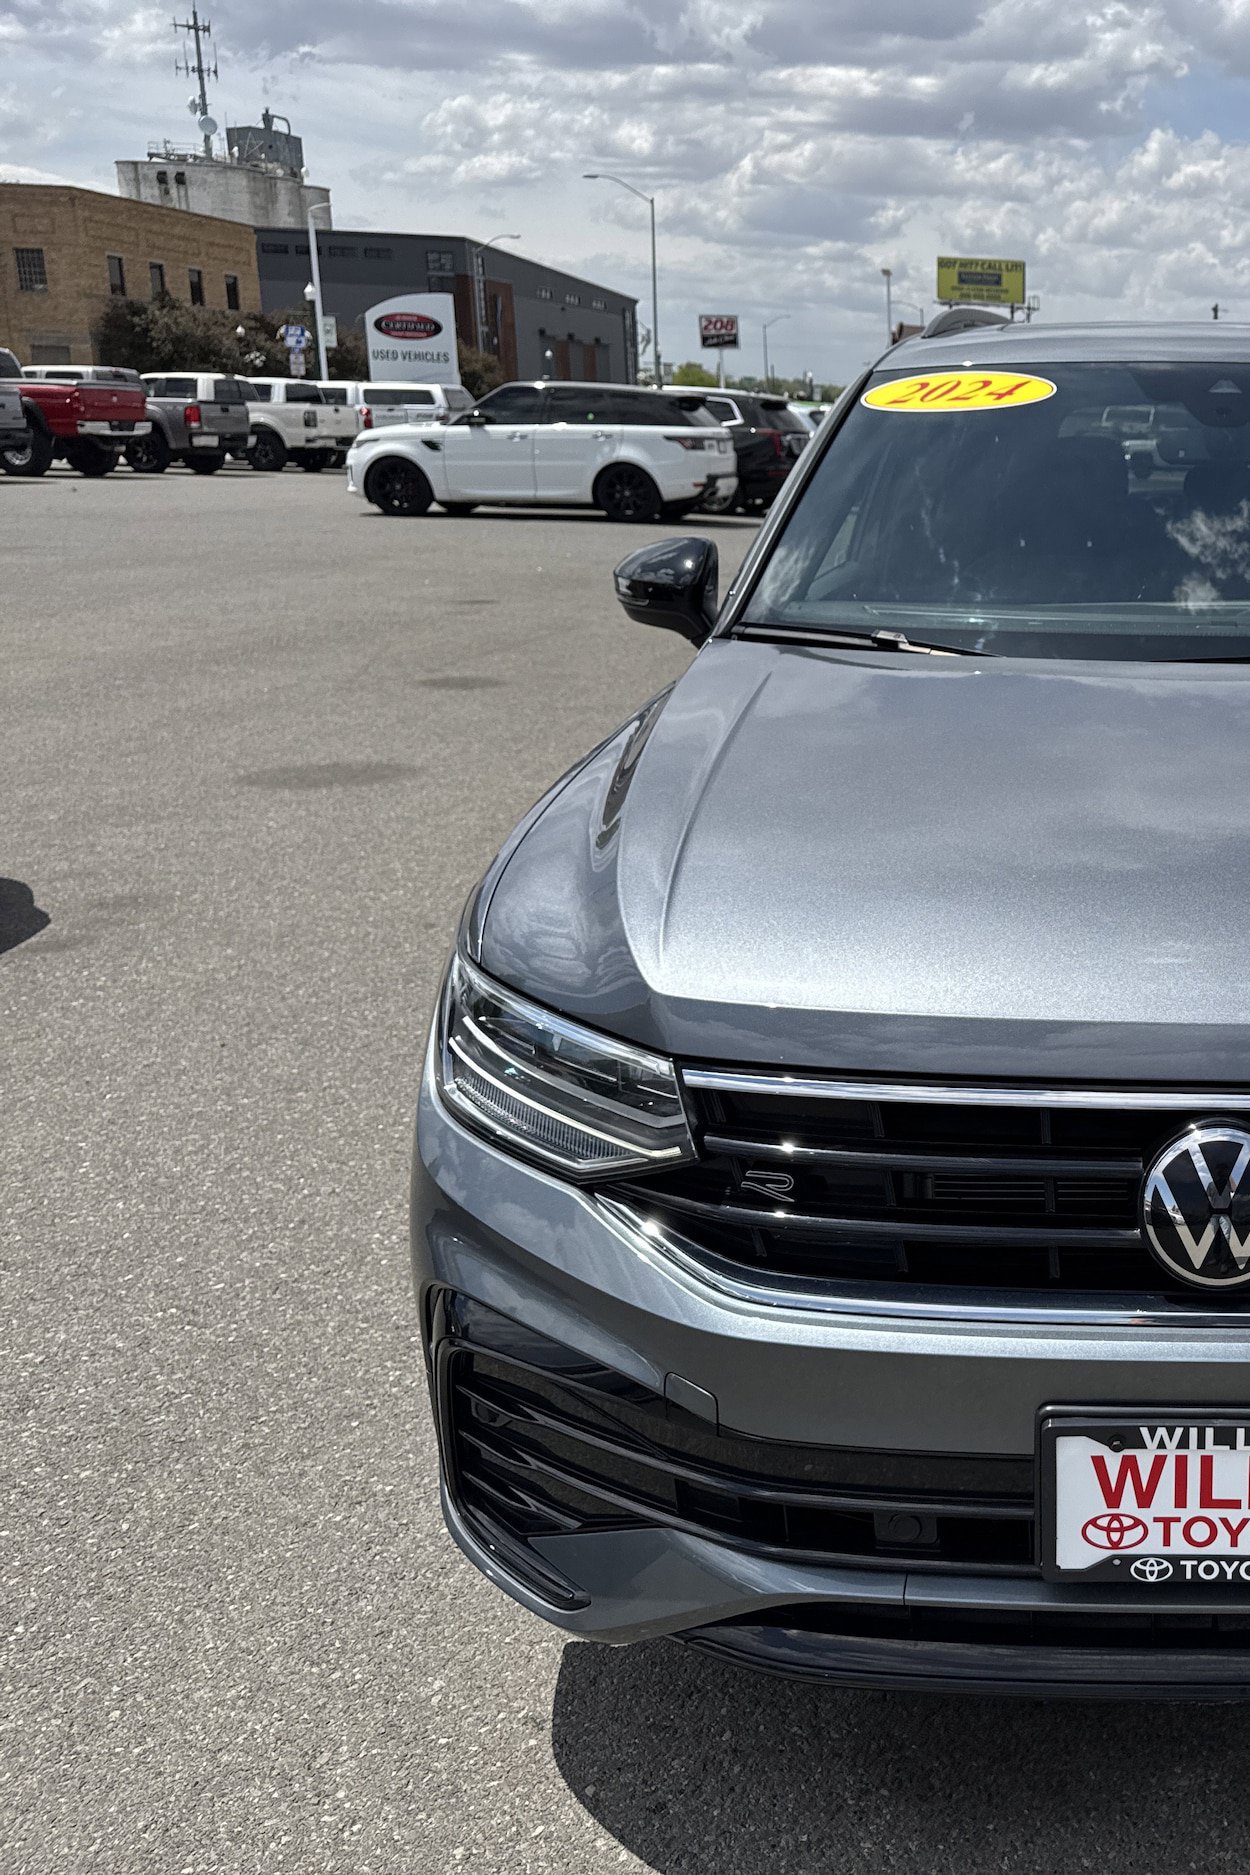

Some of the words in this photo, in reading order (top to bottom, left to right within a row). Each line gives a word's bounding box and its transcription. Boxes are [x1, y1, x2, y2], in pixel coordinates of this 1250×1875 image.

[981, 262, 1003, 271] CALL
[703, 318, 735, 332] 208
[372, 349, 399, 361] USED
[401, 350, 450, 363] VEHICLES
[885, 380, 1032, 405] 2024
